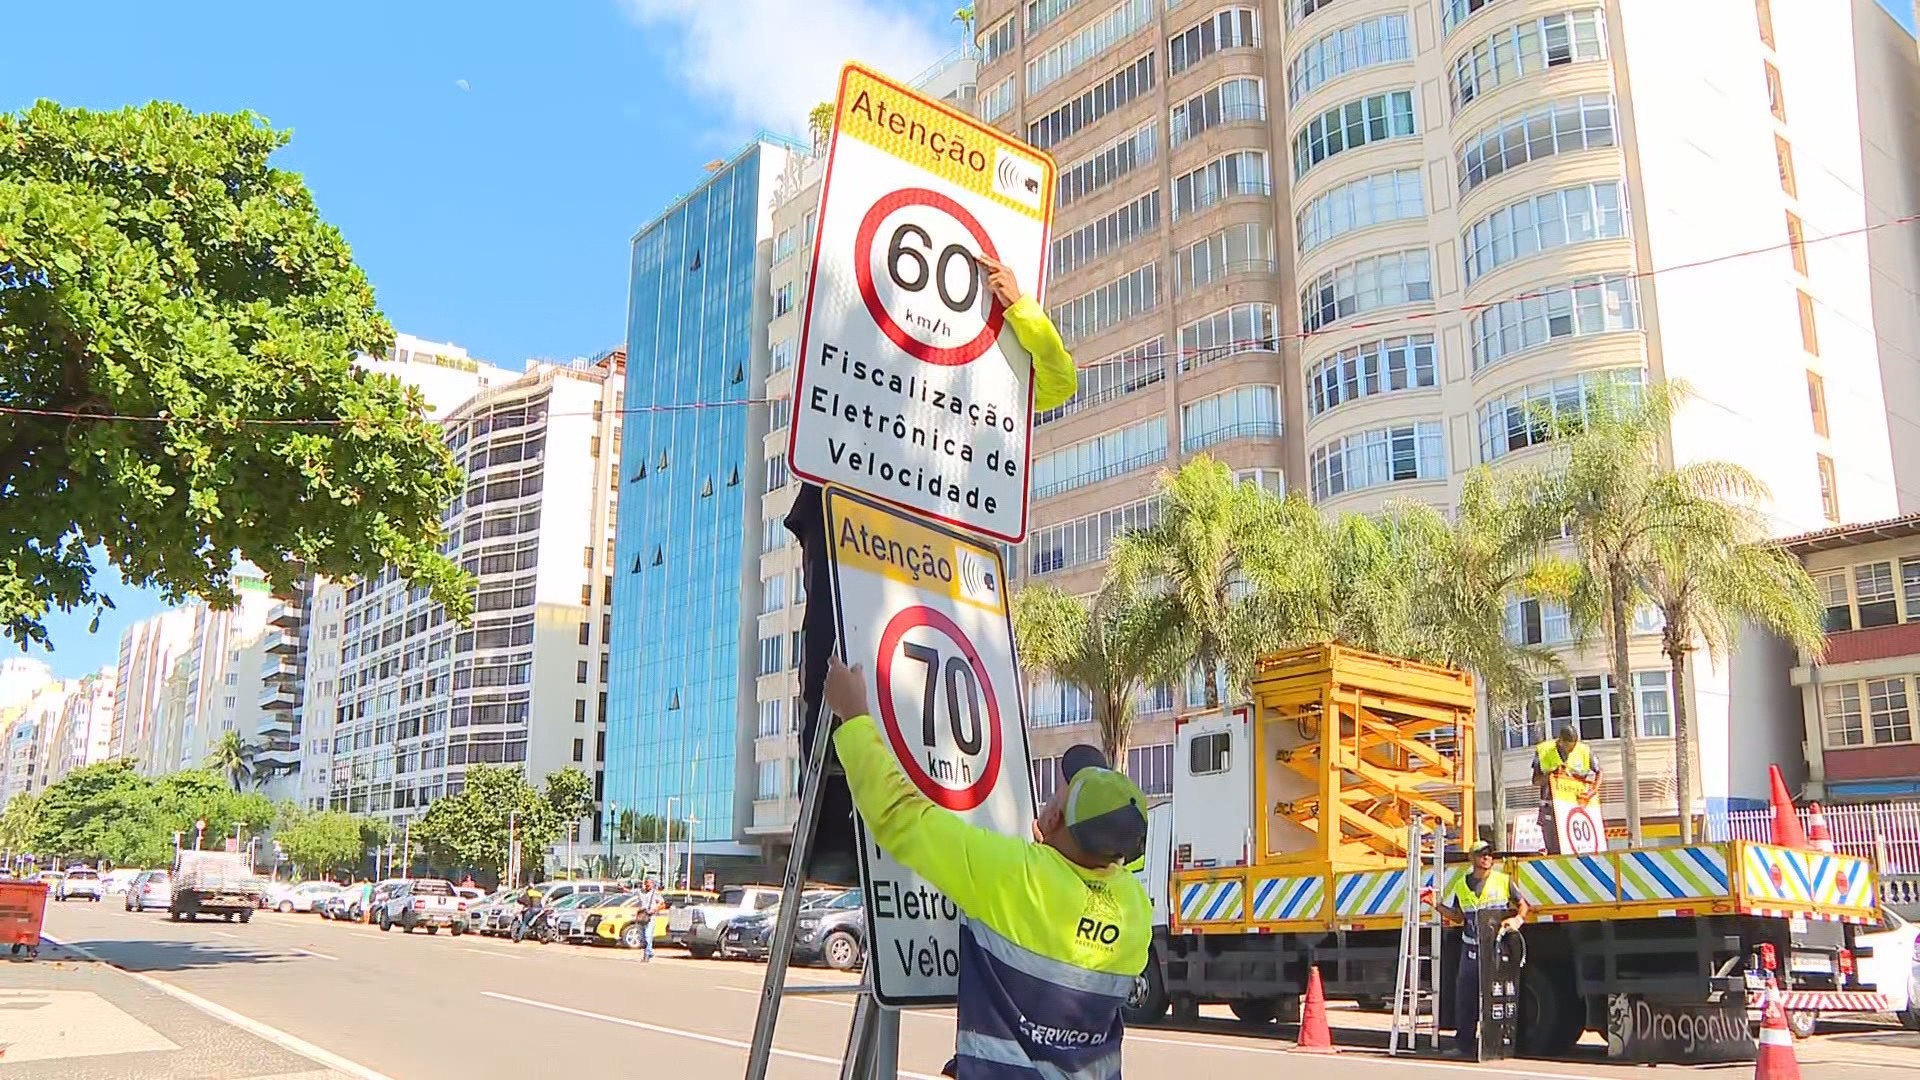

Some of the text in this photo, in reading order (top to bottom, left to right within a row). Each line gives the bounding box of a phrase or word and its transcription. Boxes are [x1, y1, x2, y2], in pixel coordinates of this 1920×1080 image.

[851, 90, 986, 172] Atenção
[887, 223, 979, 312] 60
[905, 307, 951, 337] km/h
[820, 343, 1015, 433] Fiscalização
[810, 385, 1017, 477] Eletrônica de
[828, 438, 998, 514] Velocidade
[840, 517, 953, 582] Atenção
[903, 641, 982, 756] 70
[927, 751, 972, 784] km/h
[1572, 820, 1591, 842] 60
[873, 880, 958, 921] Eletro
[894, 938, 960, 977] Velo
[1076, 917, 1120, 945] RIO
[1636, 1001, 1754, 1053] Dragonlux
